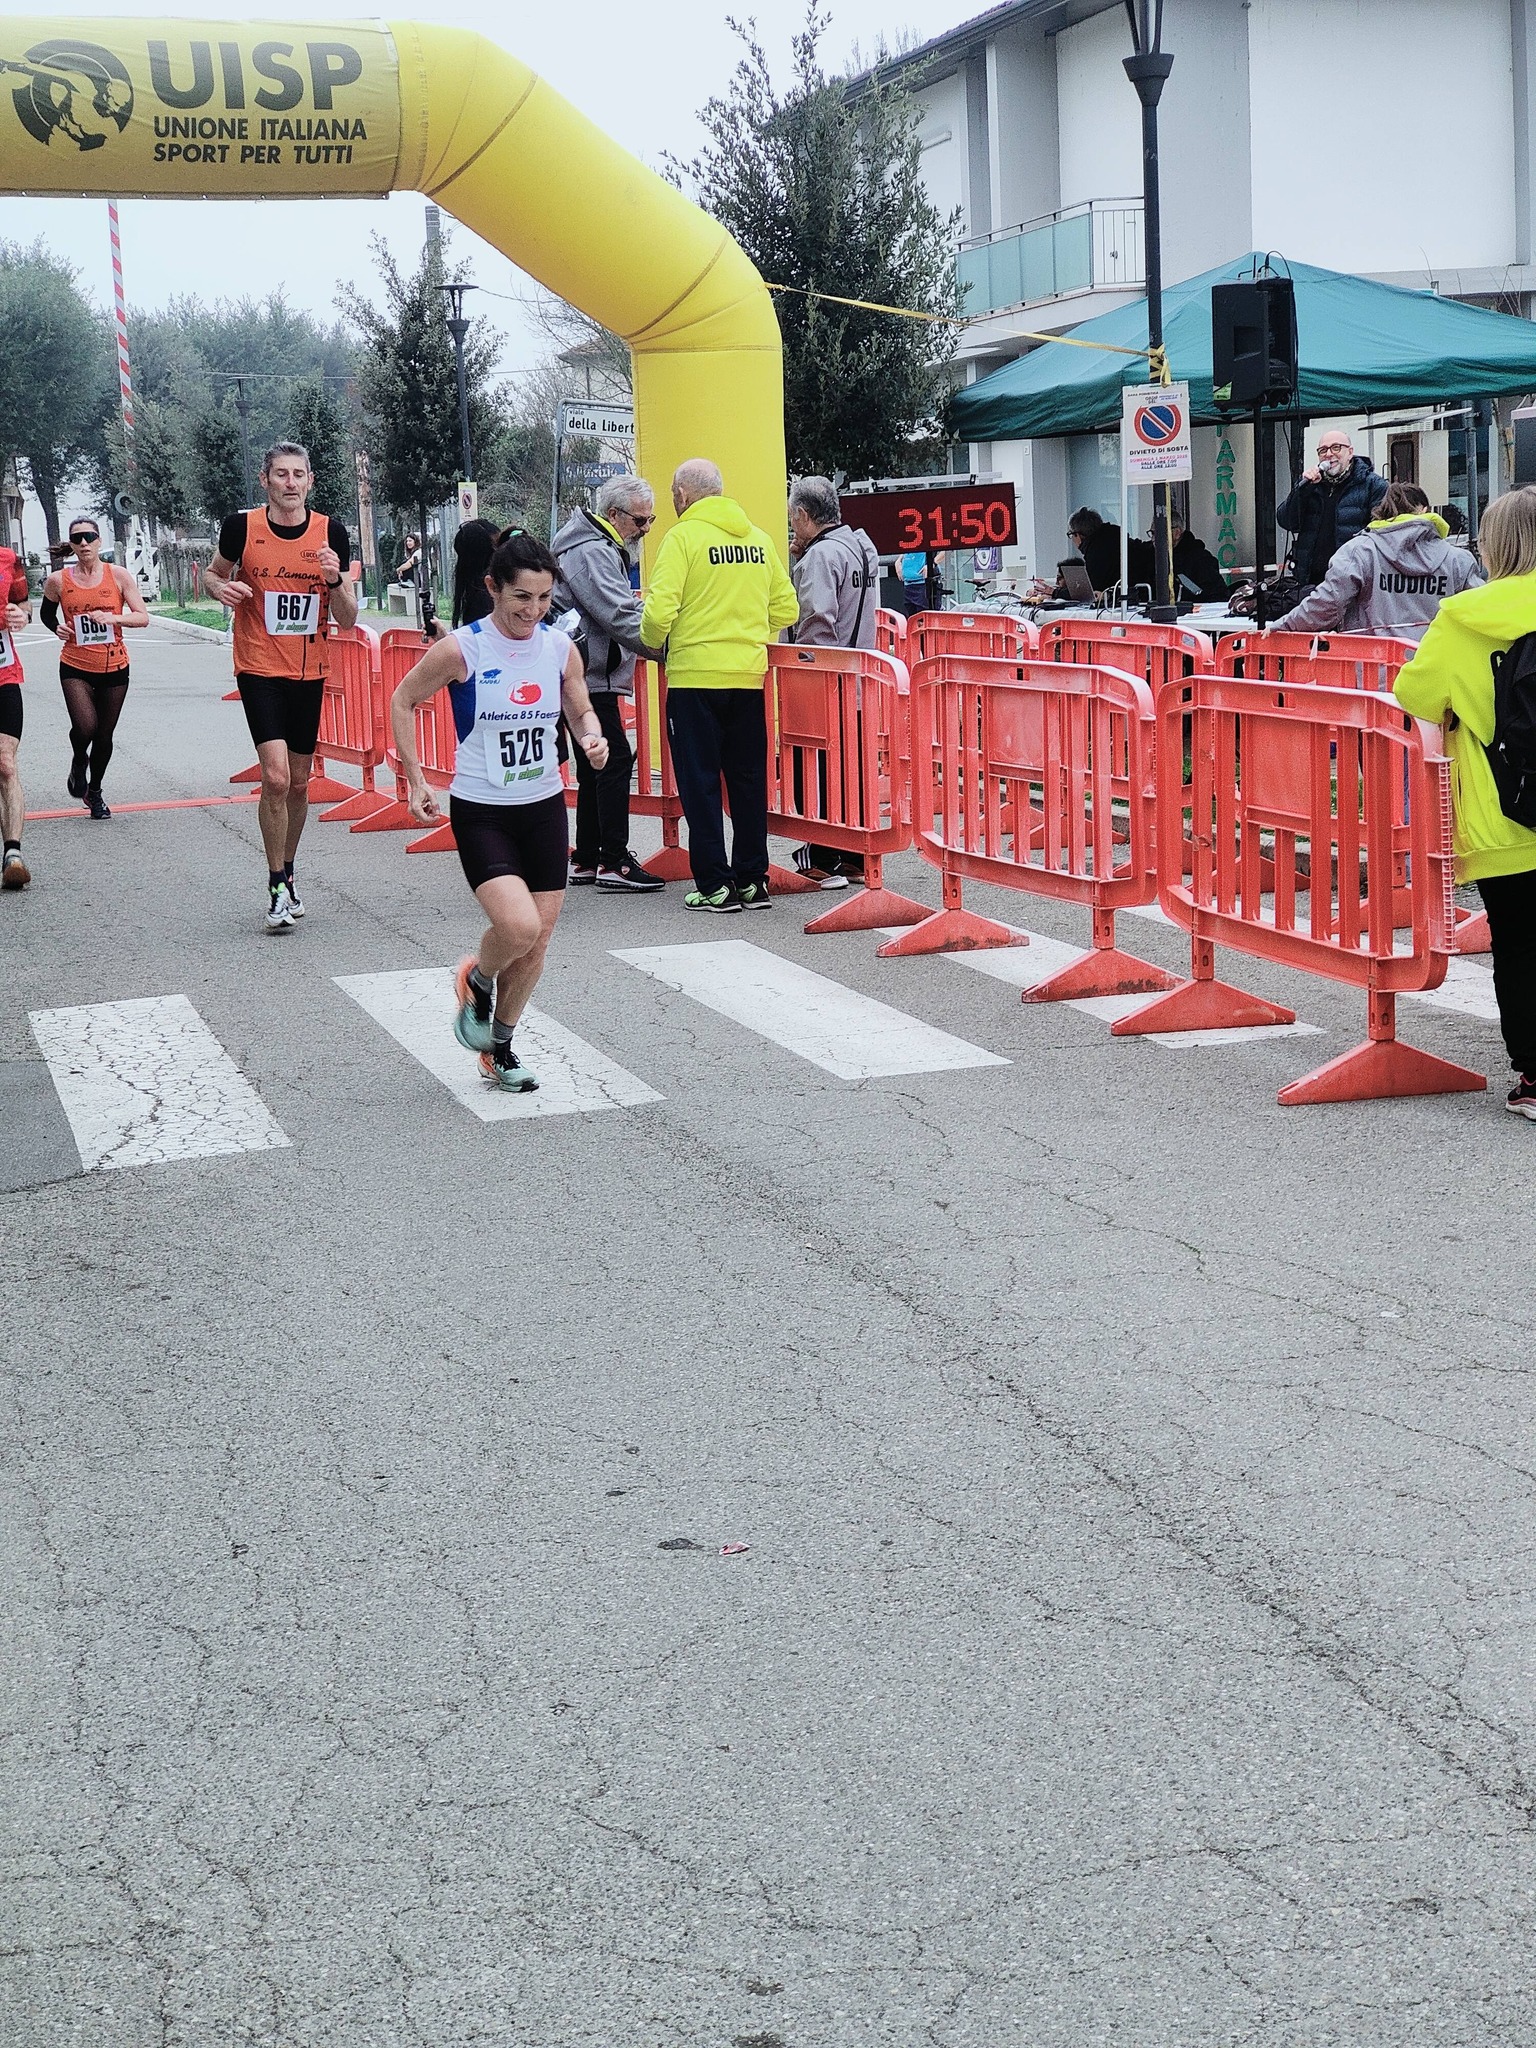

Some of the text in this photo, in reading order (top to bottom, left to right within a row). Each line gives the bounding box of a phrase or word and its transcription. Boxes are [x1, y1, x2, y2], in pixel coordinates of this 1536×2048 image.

[146, 39, 363, 111] UISP
[153, 115, 368, 141] UNIONE ITALIANA
[153, 142, 353, 164] SPORT PER TUTTI
[568, 416, 597, 431] della
[1129, 448, 1157, 456] DIVIETO
[1166, 445, 1189, 453] SOSTA
[898, 501, 1011, 549] 31:50
[708, 544, 766, 566] GIUDICE
[1379, 573, 1448, 596] GIUDICE
[276, 594, 312, 621] 667
[479, 710, 519, 721] Atletica
[520, 710, 534, 720] 85
[499, 726, 545, 768] 526
